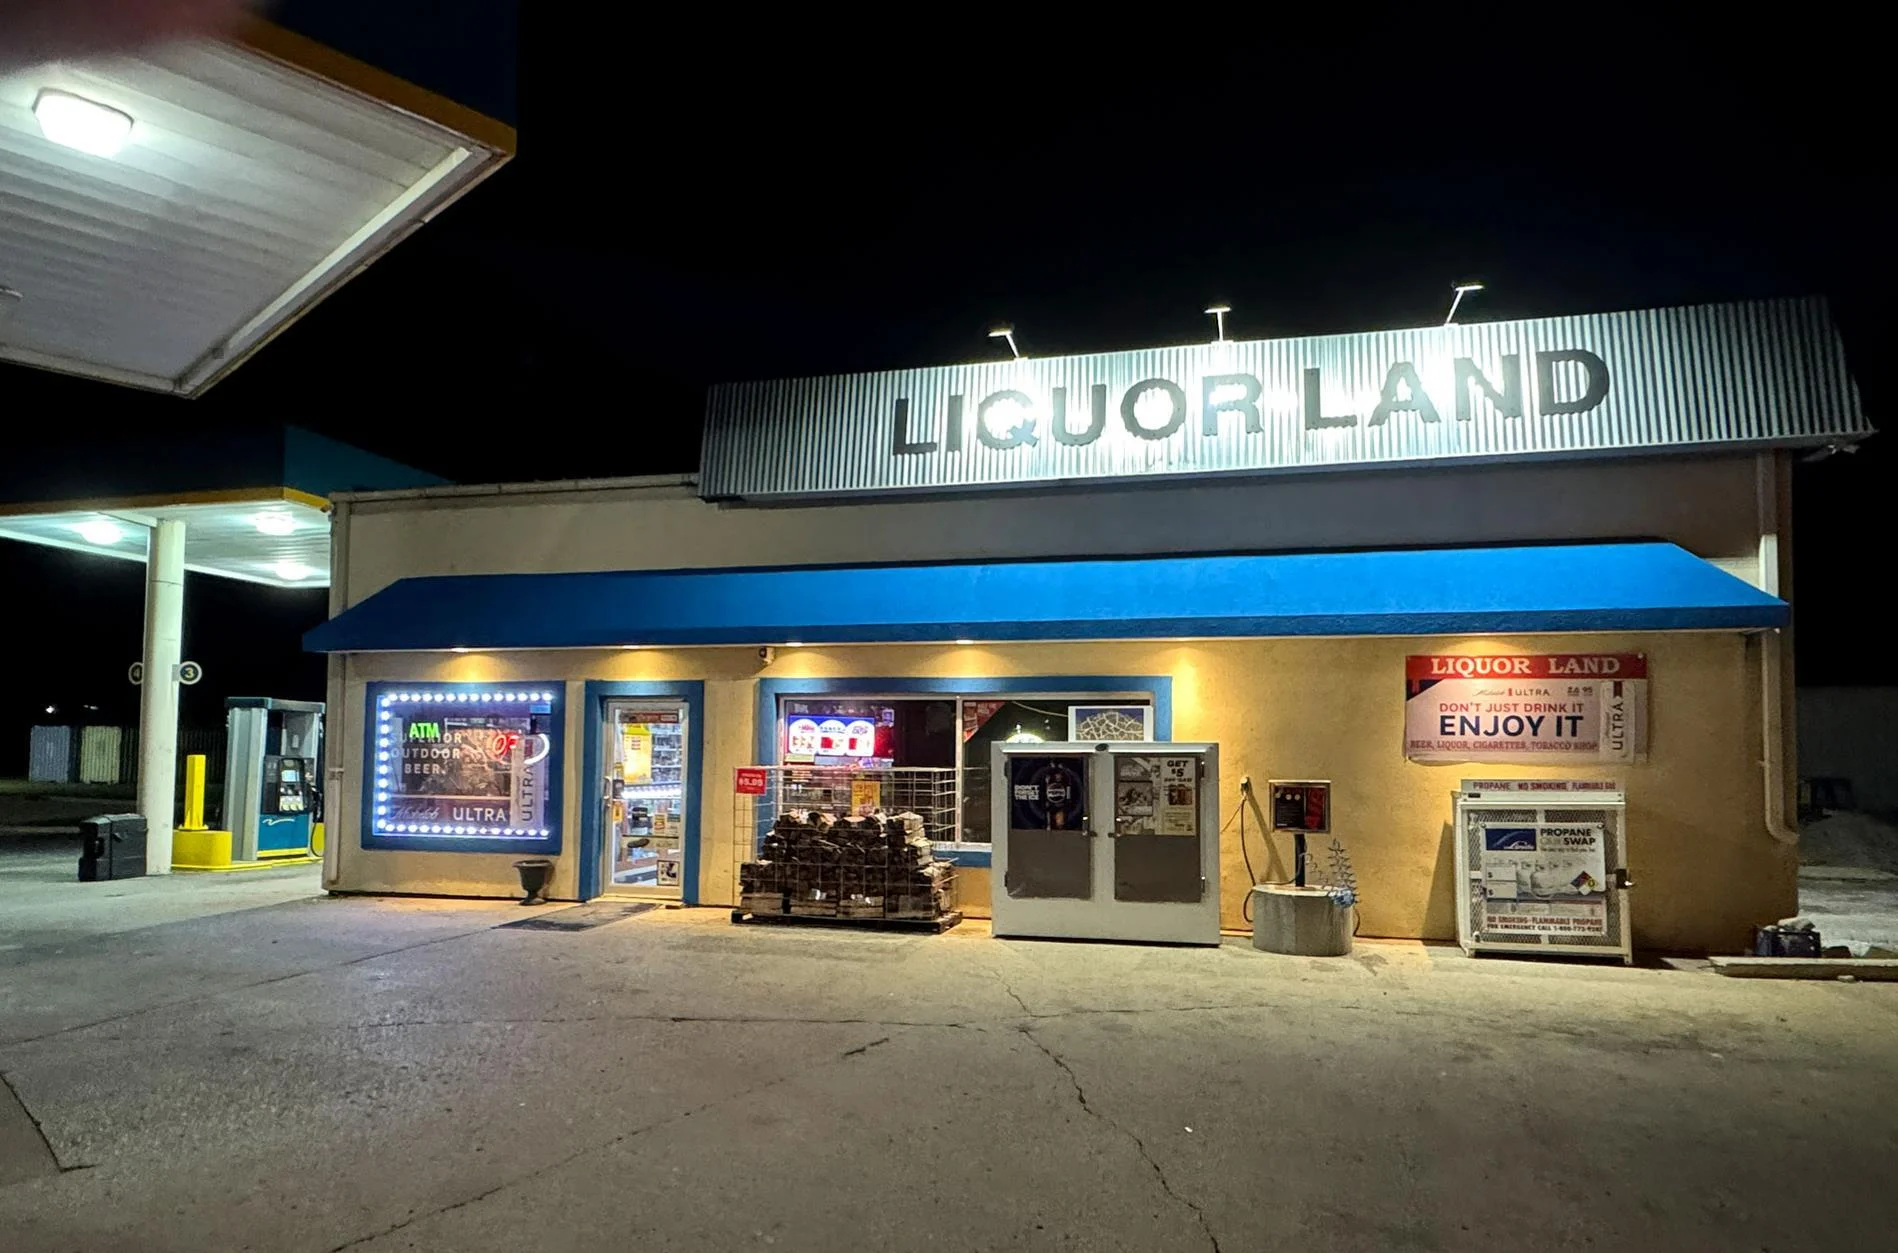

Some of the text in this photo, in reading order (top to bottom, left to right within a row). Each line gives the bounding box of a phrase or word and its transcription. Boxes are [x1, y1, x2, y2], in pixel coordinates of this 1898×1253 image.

[892, 349, 1610, 456] LIQUOR LAND
[184, 667, 194, 678] 3
[1431, 657, 1620, 677] LIQUOR LAND
[1515, 688, 1550, 697] ULTRA
[1439, 702, 1584, 713] DON'T JUST DRINK IT
[409, 722, 440, 738] ATM
[1439, 715, 1545, 737] ENJOY
[1556, 715, 1584, 737] IT
[1612, 702, 1624, 751] ULTRA
[391, 748, 461, 759] OUTDOOR
[522, 764, 534, 821] ULTRA
[1473, 782, 1511, 790] PROPANE
[1518, 782, 1529, 790] NO
[1531, 782, 1567, 790] SMOKING
[453, 807, 506, 822] ULTRA
[1541, 828, 1591, 837] PROPANE
[1563, 838, 1596, 846] SWAP
